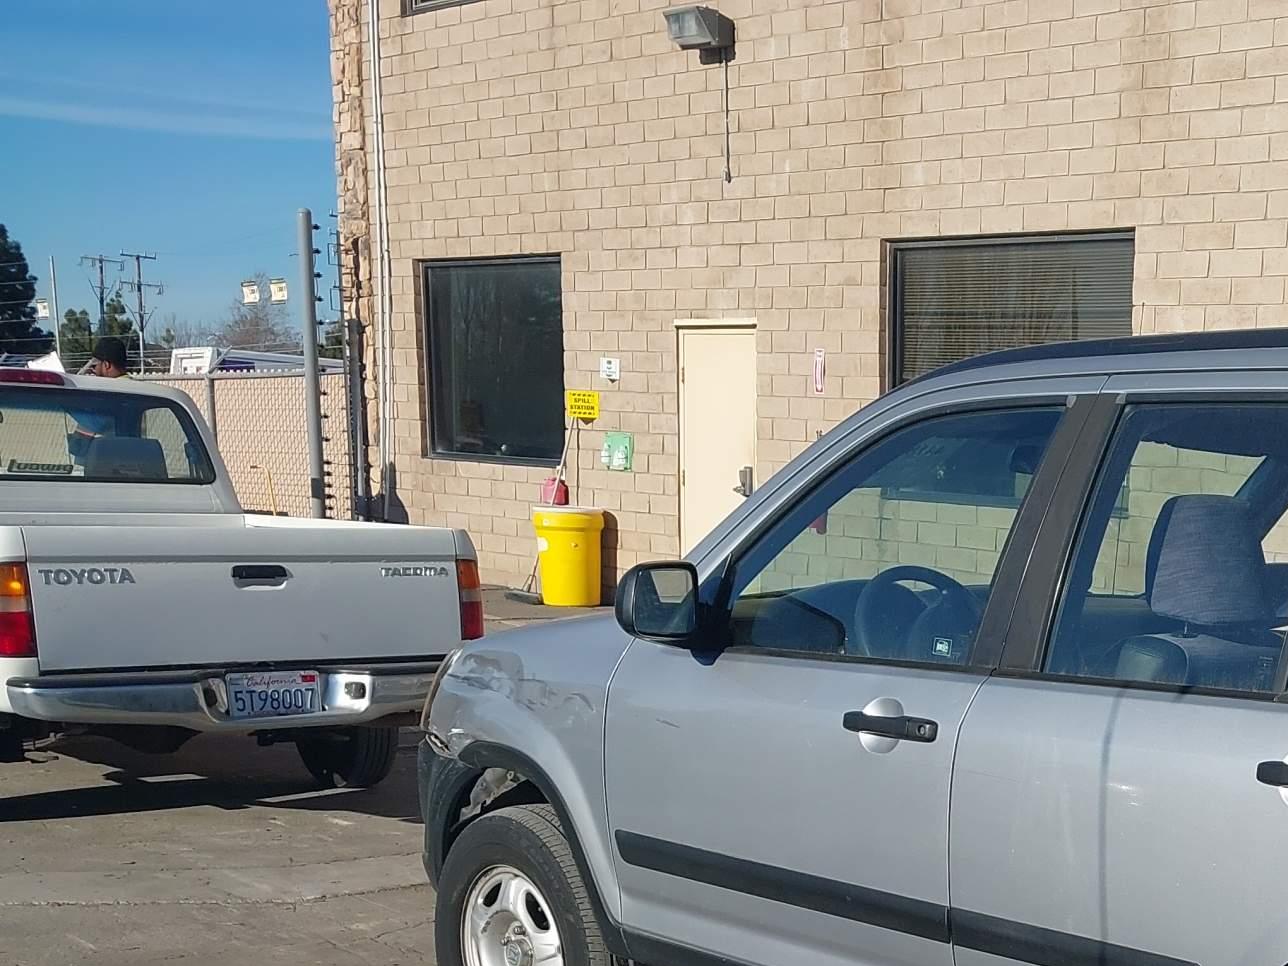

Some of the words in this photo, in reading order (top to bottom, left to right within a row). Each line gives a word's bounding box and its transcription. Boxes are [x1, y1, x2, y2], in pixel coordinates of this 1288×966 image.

[38, 568, 136, 585] TOYOTA
[246, 675, 297, 689] California
[234, 687, 315, 712] 5T98007
